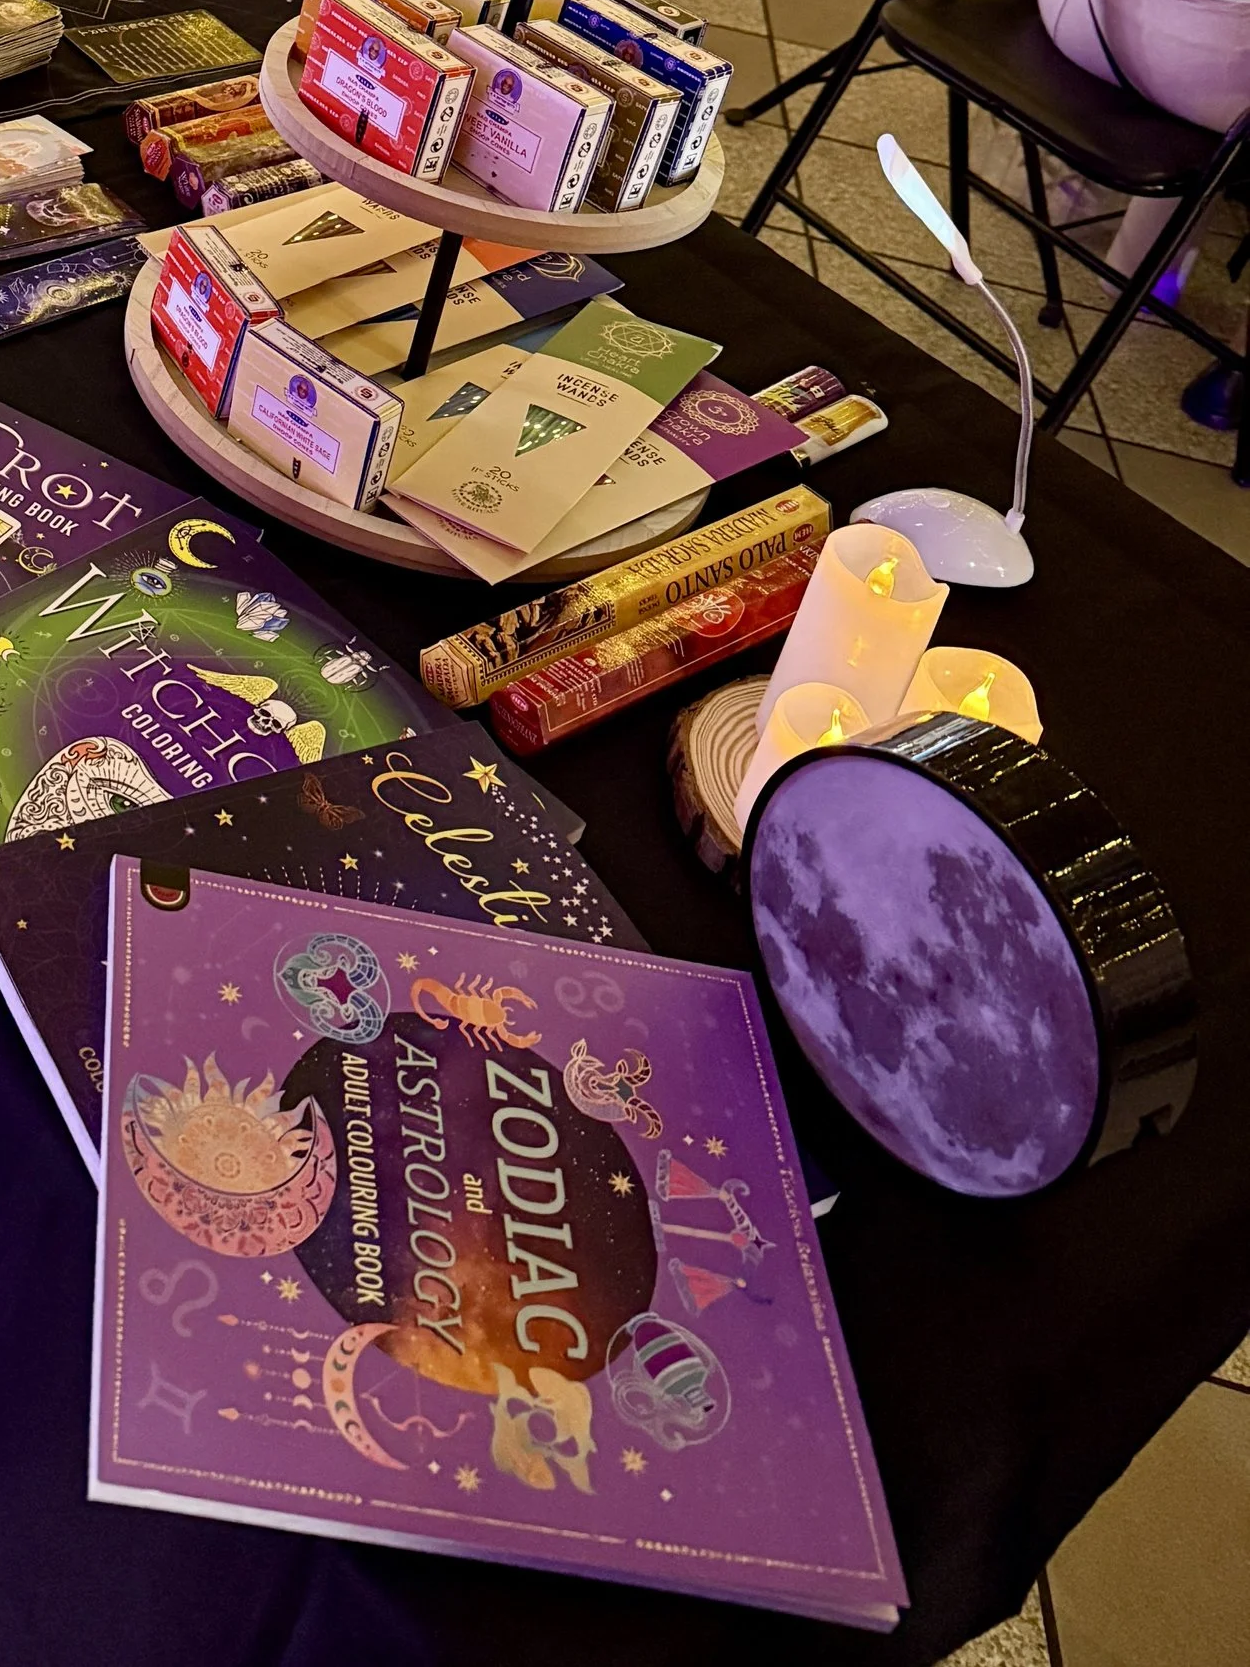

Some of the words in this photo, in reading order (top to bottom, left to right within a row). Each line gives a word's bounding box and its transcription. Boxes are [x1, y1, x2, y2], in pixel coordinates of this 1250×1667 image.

[336, 76, 366, 102] DRAGON'S
[366, 98, 388, 118] BLOOD
[465, 112, 489, 132] WEET
[489, 125, 528, 159] VANILLA
[250, 248, 269, 260] 20
[586, 349, 640, 376] Chakra
[599, 345, 642, 365] Heart
[556, 373, 619, 403] INCENSE
[556, 381, 607, 408] WANDS
[258, 404, 297, 435] CALIFORNIAN
[295, 430, 315, 450] WHITE
[314, 443, 332, 461] SAGE
[657, 415, 705, 447] Chakra
[665, 409, 711, 441] Crown
[489, 465, 512, 480] 20
[623, 447, 650, 468] NDS
[629, 441, 666, 466] ENSE
[484, 470, 520, 492] STICKS
[25, 501, 79, 537] BOOK
[712, 507, 777, 556] MADERA
[627, 535, 711, 576] SAGRADA
[736, 532, 787, 571] PALO
[665, 559, 734, 606] SANTO
[38, 562, 278, 782] WITCHC
[120, 702, 213, 789] COLORING
[371, 751, 551, 929] Celesti
[341, 1051, 371, 1119] ADULT
[346, 1119, 381, 1239] COLOURING
[393, 1034, 467, 1356] ASTROLOGY
[462, 1172, 494, 1215] and
[485, 1058, 589, 1361] ZODIAC
[353, 1241, 385, 1307] BOOK
